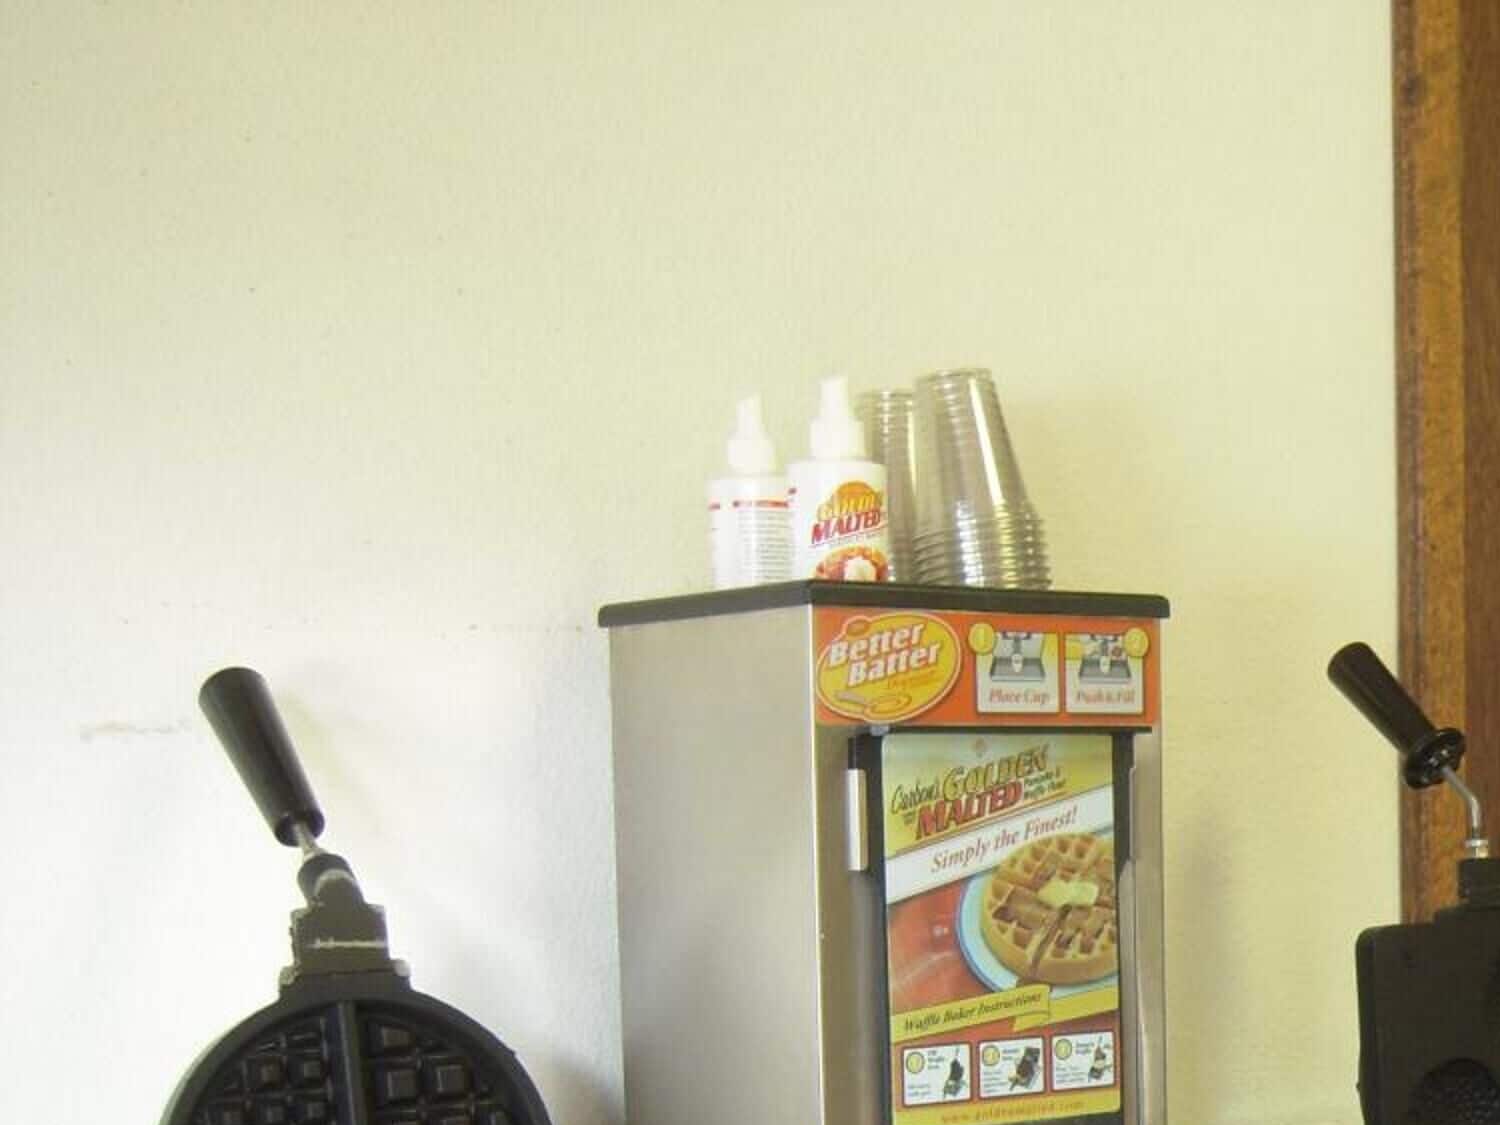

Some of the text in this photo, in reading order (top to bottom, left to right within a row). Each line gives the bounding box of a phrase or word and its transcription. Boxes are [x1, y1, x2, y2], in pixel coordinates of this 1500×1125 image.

[811, 507, 883, 545] MALTED
[830, 623, 925, 667] Better
[848, 643, 941, 687] Batter
[916, 780, 1024, 840] MALTED
[931, 805, 1078, 873] Simply the Finest!
